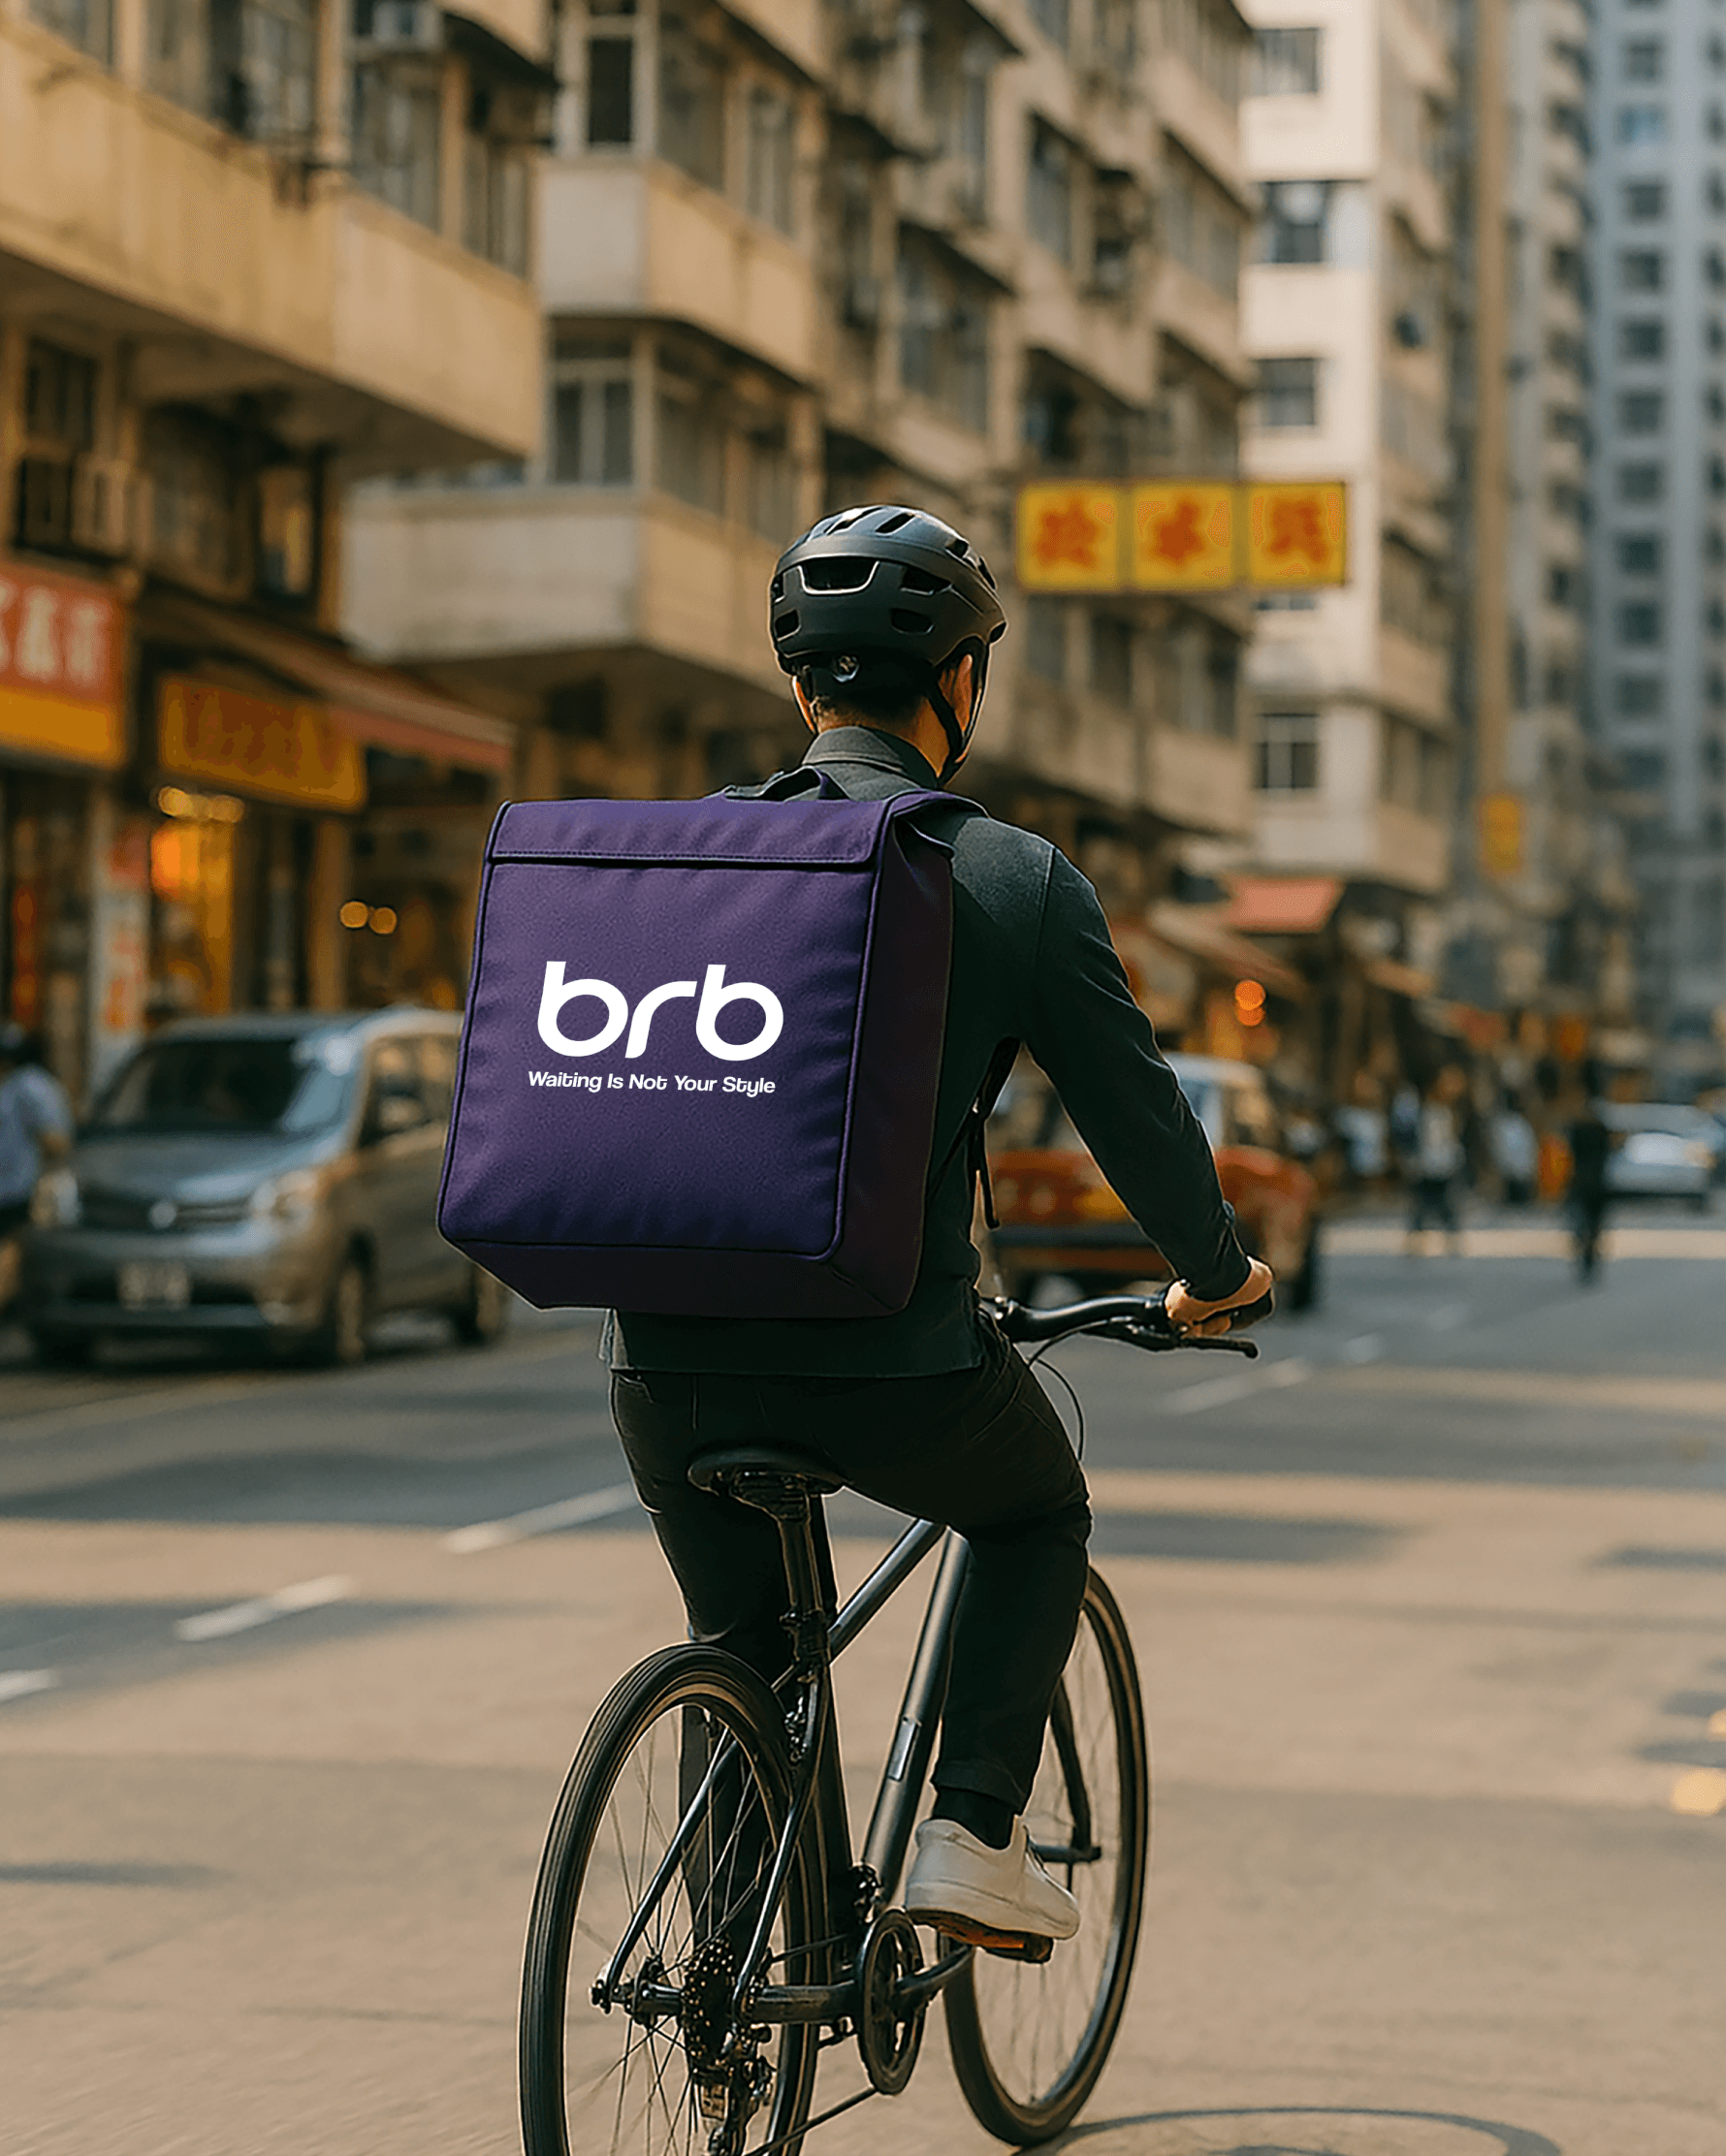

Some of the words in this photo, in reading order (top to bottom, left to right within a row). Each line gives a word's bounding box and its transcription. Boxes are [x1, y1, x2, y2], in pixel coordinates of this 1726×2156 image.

[537, 961, 784, 1062] brb
[527, 1070, 602, 1094] Waiting
[607, 1073, 623, 1089] Is
[628, 1073, 667, 1091] Not
[674, 1074, 718, 1092] Your
[721, 1076, 776, 1098] Style
